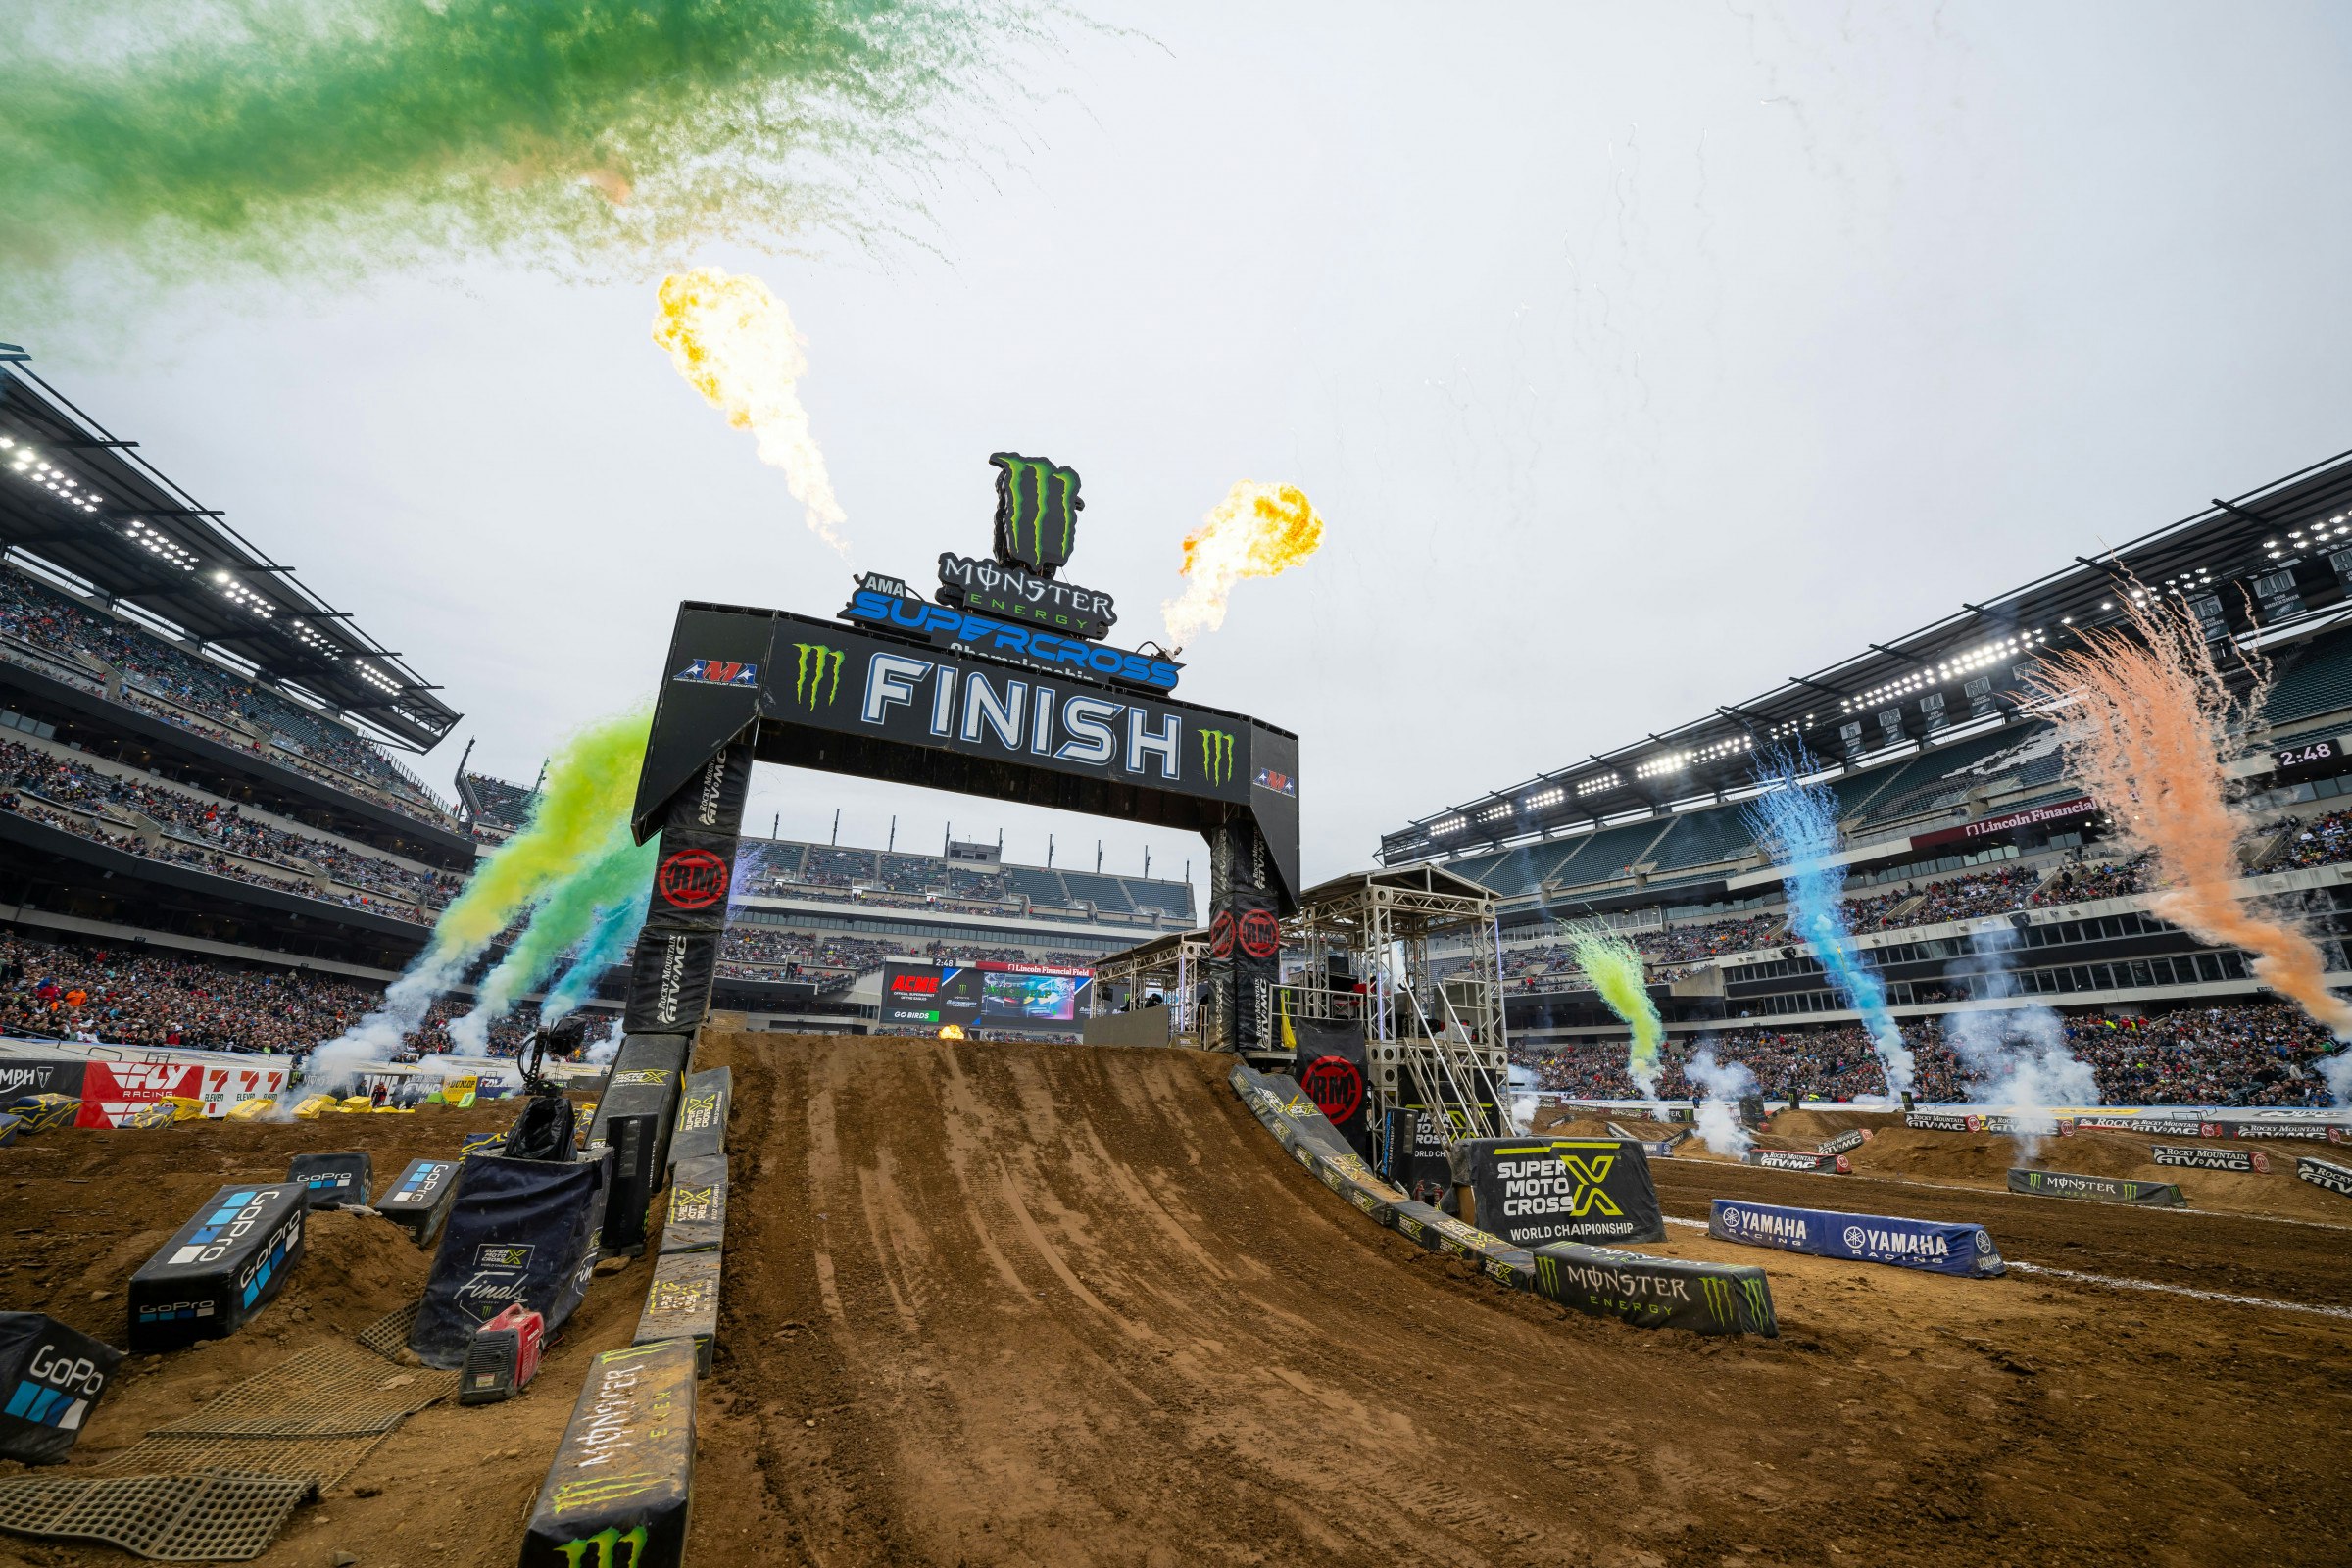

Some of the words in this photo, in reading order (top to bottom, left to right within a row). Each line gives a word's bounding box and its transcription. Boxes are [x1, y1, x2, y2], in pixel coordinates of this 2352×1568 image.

[864, 576, 906, 597] AMA
[2260, 573, 2292, 597] 40
[970, 593, 1088, 629] ENERGY
[847, 590, 1178, 687] SUPERCROSS
[673, 659, 759, 685] AMA
[860, 652, 1182, 780] FINISH
[2281, 744, 2332, 766] 2:48
[1254, 767, 1296, 796] AMA
[1979, 813, 2031, 835] Lincoln
[2032, 797, 2097, 823] Financial
[662, 935, 676, 981] MOUNTAIN
[1043, 966, 1071, 975] Financial
[890, 975, 939, 993] ACME
[658, 982, 668, 1009] ROCKY
[0, 1069, 35, 1085] MPH
[2096, 1117, 2131, 1126] ROCK
[2167, 1148, 2195, 1156] ROCKY
[2197, 1151, 2248, 1160] MOUNTAIN
[297, 1172, 352, 1183] GoPro
[1497, 1159, 1568, 1179] SUPER
[2316, 1167, 2352, 1184] ROCKY
[411, 1164, 448, 1202] GoPro
[1505, 1177, 1570, 1198] MOTO
[1503, 1196, 1575, 1217] CROSS
[199, 1191, 280, 1263] GoPro
[1510, 1226, 1552, 1242] WORLD
[1741, 1210, 1807, 1240] YAMAHA
[1729, 1227, 1801, 1247] RACING
[1867, 1229, 1949, 1256] YAMAHA
[239, 1209, 301, 1289] GoPro
[1852, 1249, 1942, 1264] RACING
[453, 1271, 528, 1303] Finals
[139, 1299, 215, 1314] GoPro
[1590, 1295, 1672, 1316] ENERGY
[30, 1345, 104, 1395] GoPo
